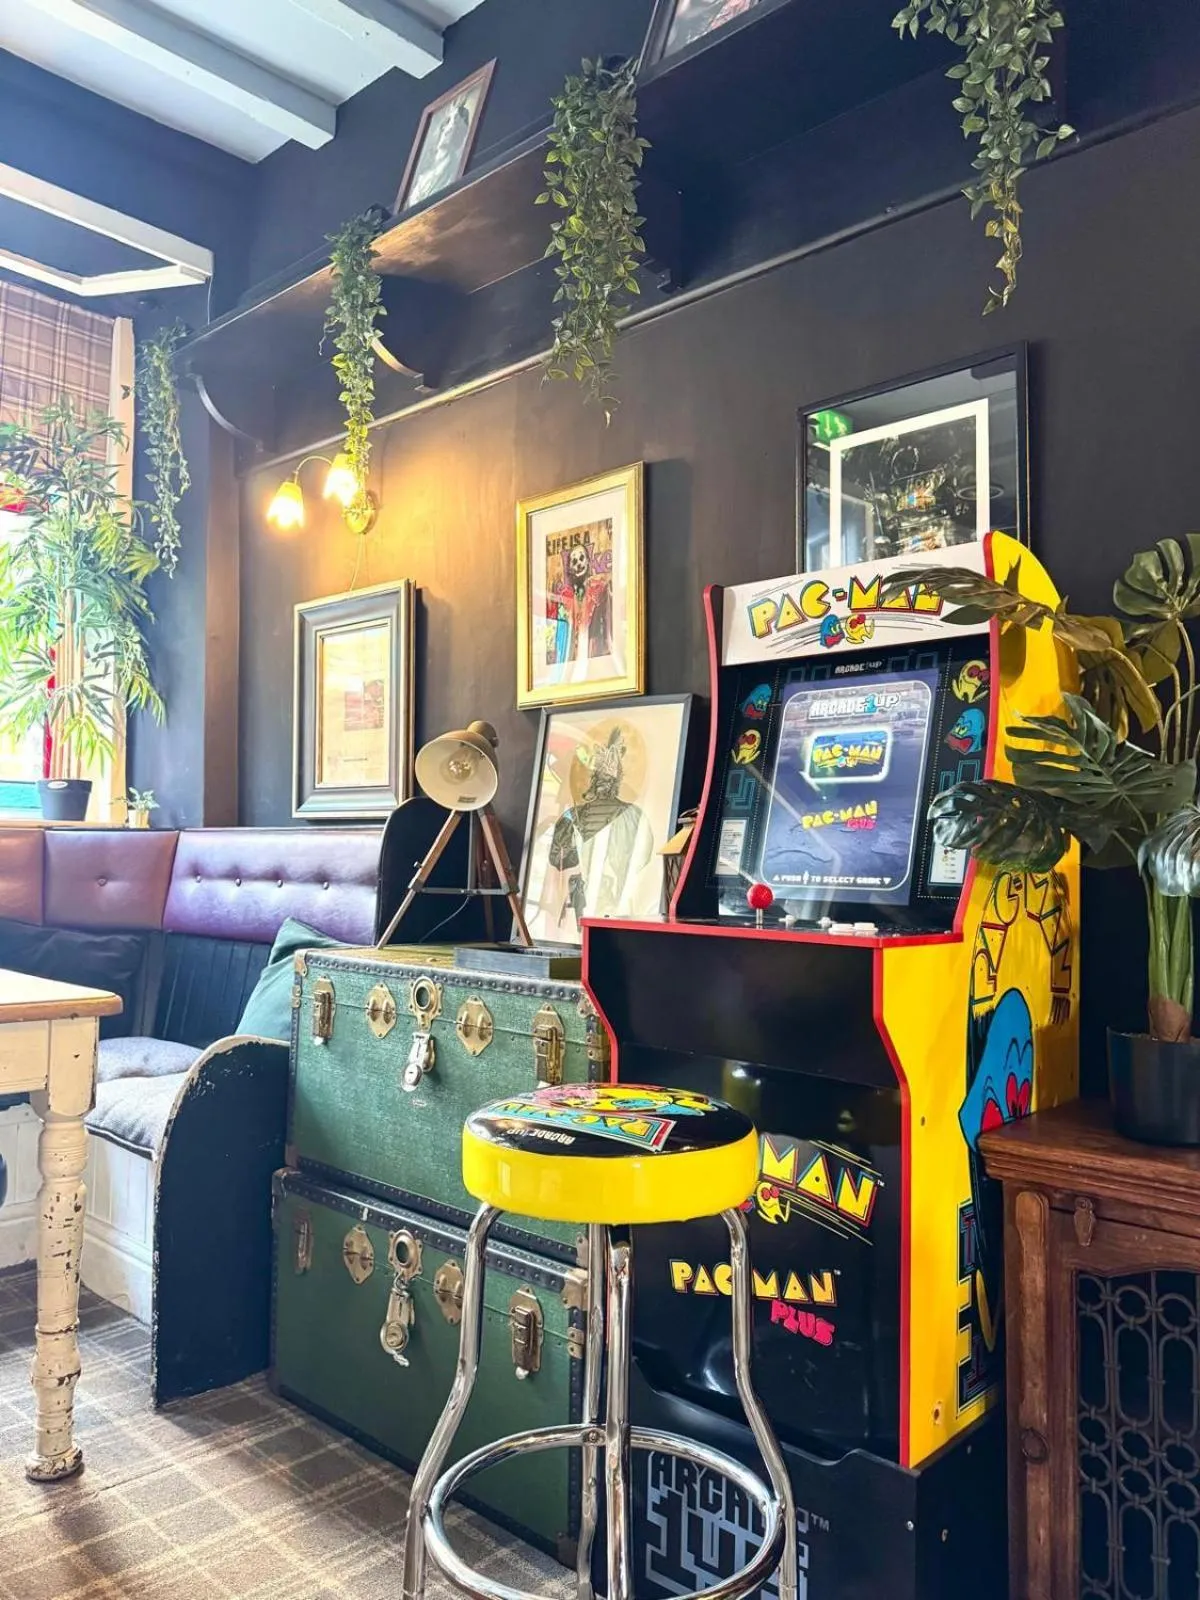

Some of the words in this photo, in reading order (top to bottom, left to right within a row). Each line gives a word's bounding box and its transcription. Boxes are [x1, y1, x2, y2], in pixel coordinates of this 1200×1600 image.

[570, 533, 580, 548] IS
[583, 530, 590, 545] A
[813, 744, 882, 763] PAC-MAN
[802, 800, 877, 829] PAC-MAN
[811, 875, 820, 883] TO
[823, 876, 854, 884] SELECT
[770, 1299, 836, 1346] PLUS
